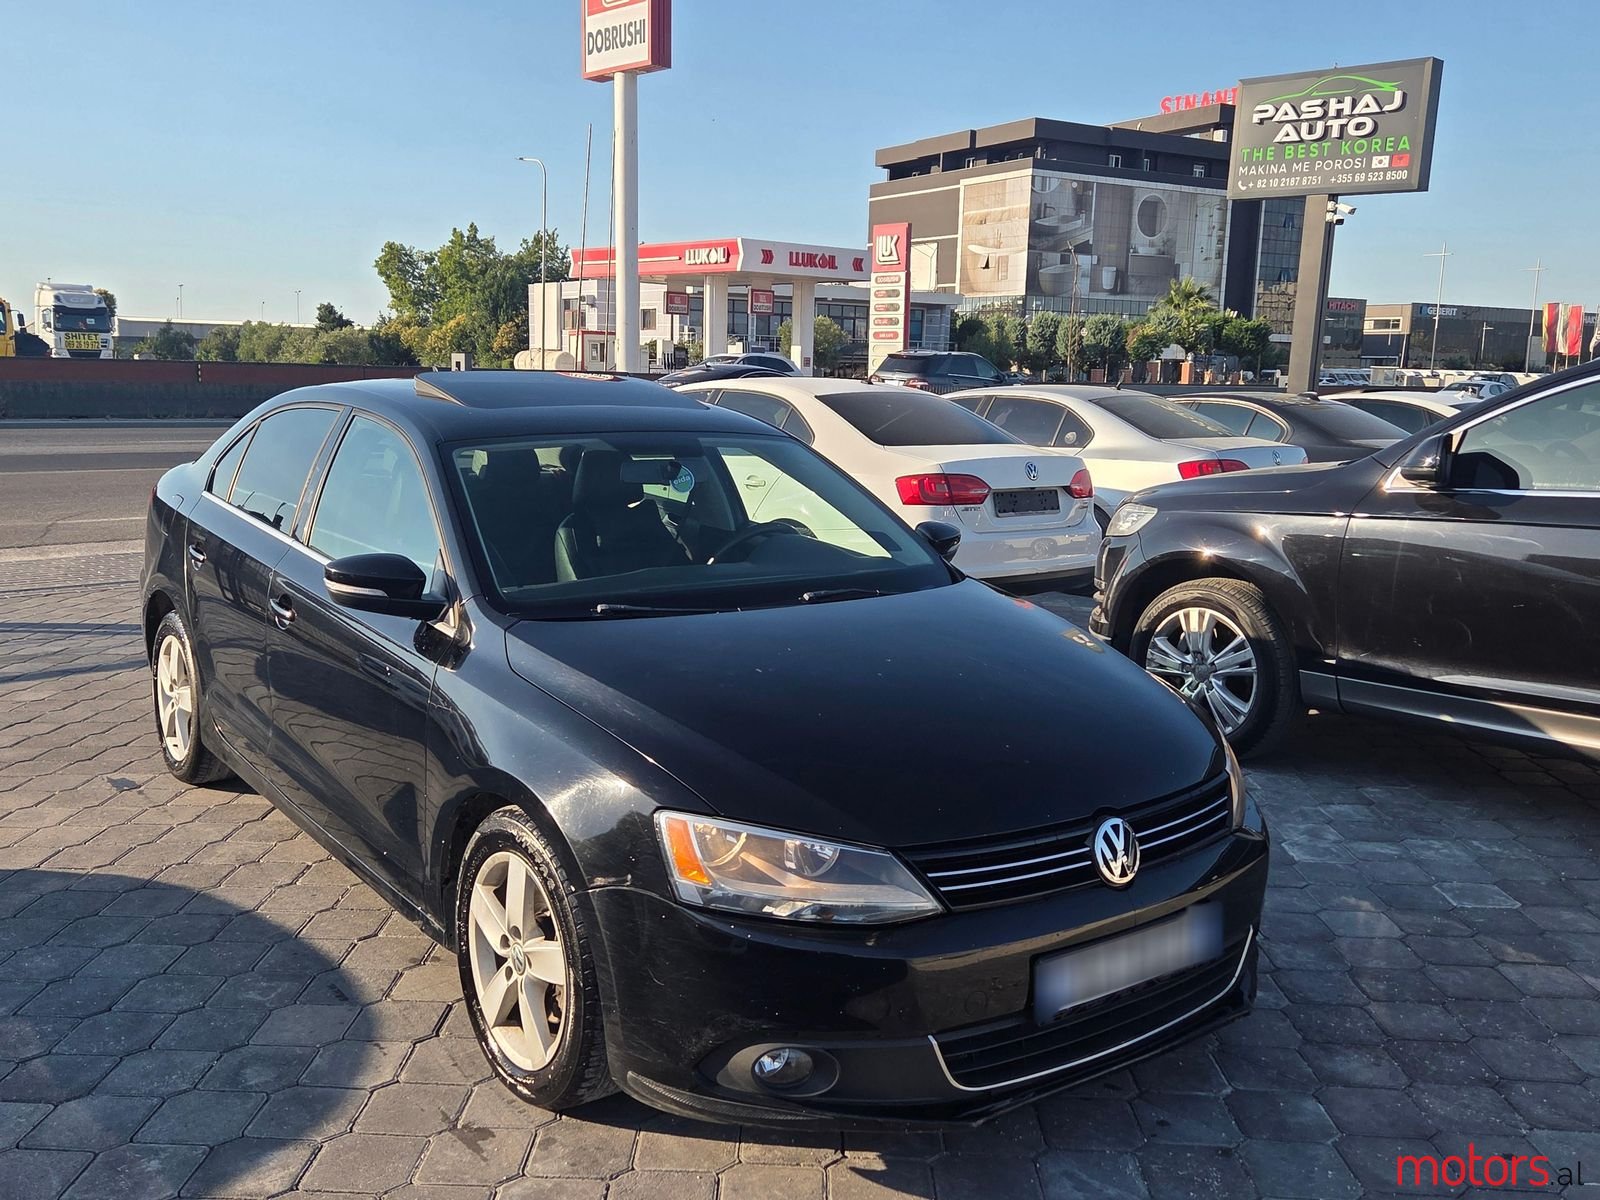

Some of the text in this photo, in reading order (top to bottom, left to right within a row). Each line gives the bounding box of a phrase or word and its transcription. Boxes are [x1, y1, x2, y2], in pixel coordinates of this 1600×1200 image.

[587, 19, 646, 55] DOBRUSHI
[1252, 90, 1405, 124] PASHAJ
[1273, 116, 1376, 143] AUTO
[1241, 136, 1410, 162] THE BEST KOREA
[1238, 158, 1366, 176] MAKINA ME POROSI
[1256, 179, 1266, 188] 82
[1269, 178, 1278, 187] 10
[1330, 173, 1353, 183] +355
[1354, 172, 1366, 182] 69
[1367, 171, 1384, 181] 523
[1385, 169, 1408, 180] 8500
[1328, 301, 1359, 311] HITACHI
[64, 333, 99, 341] SHITET
